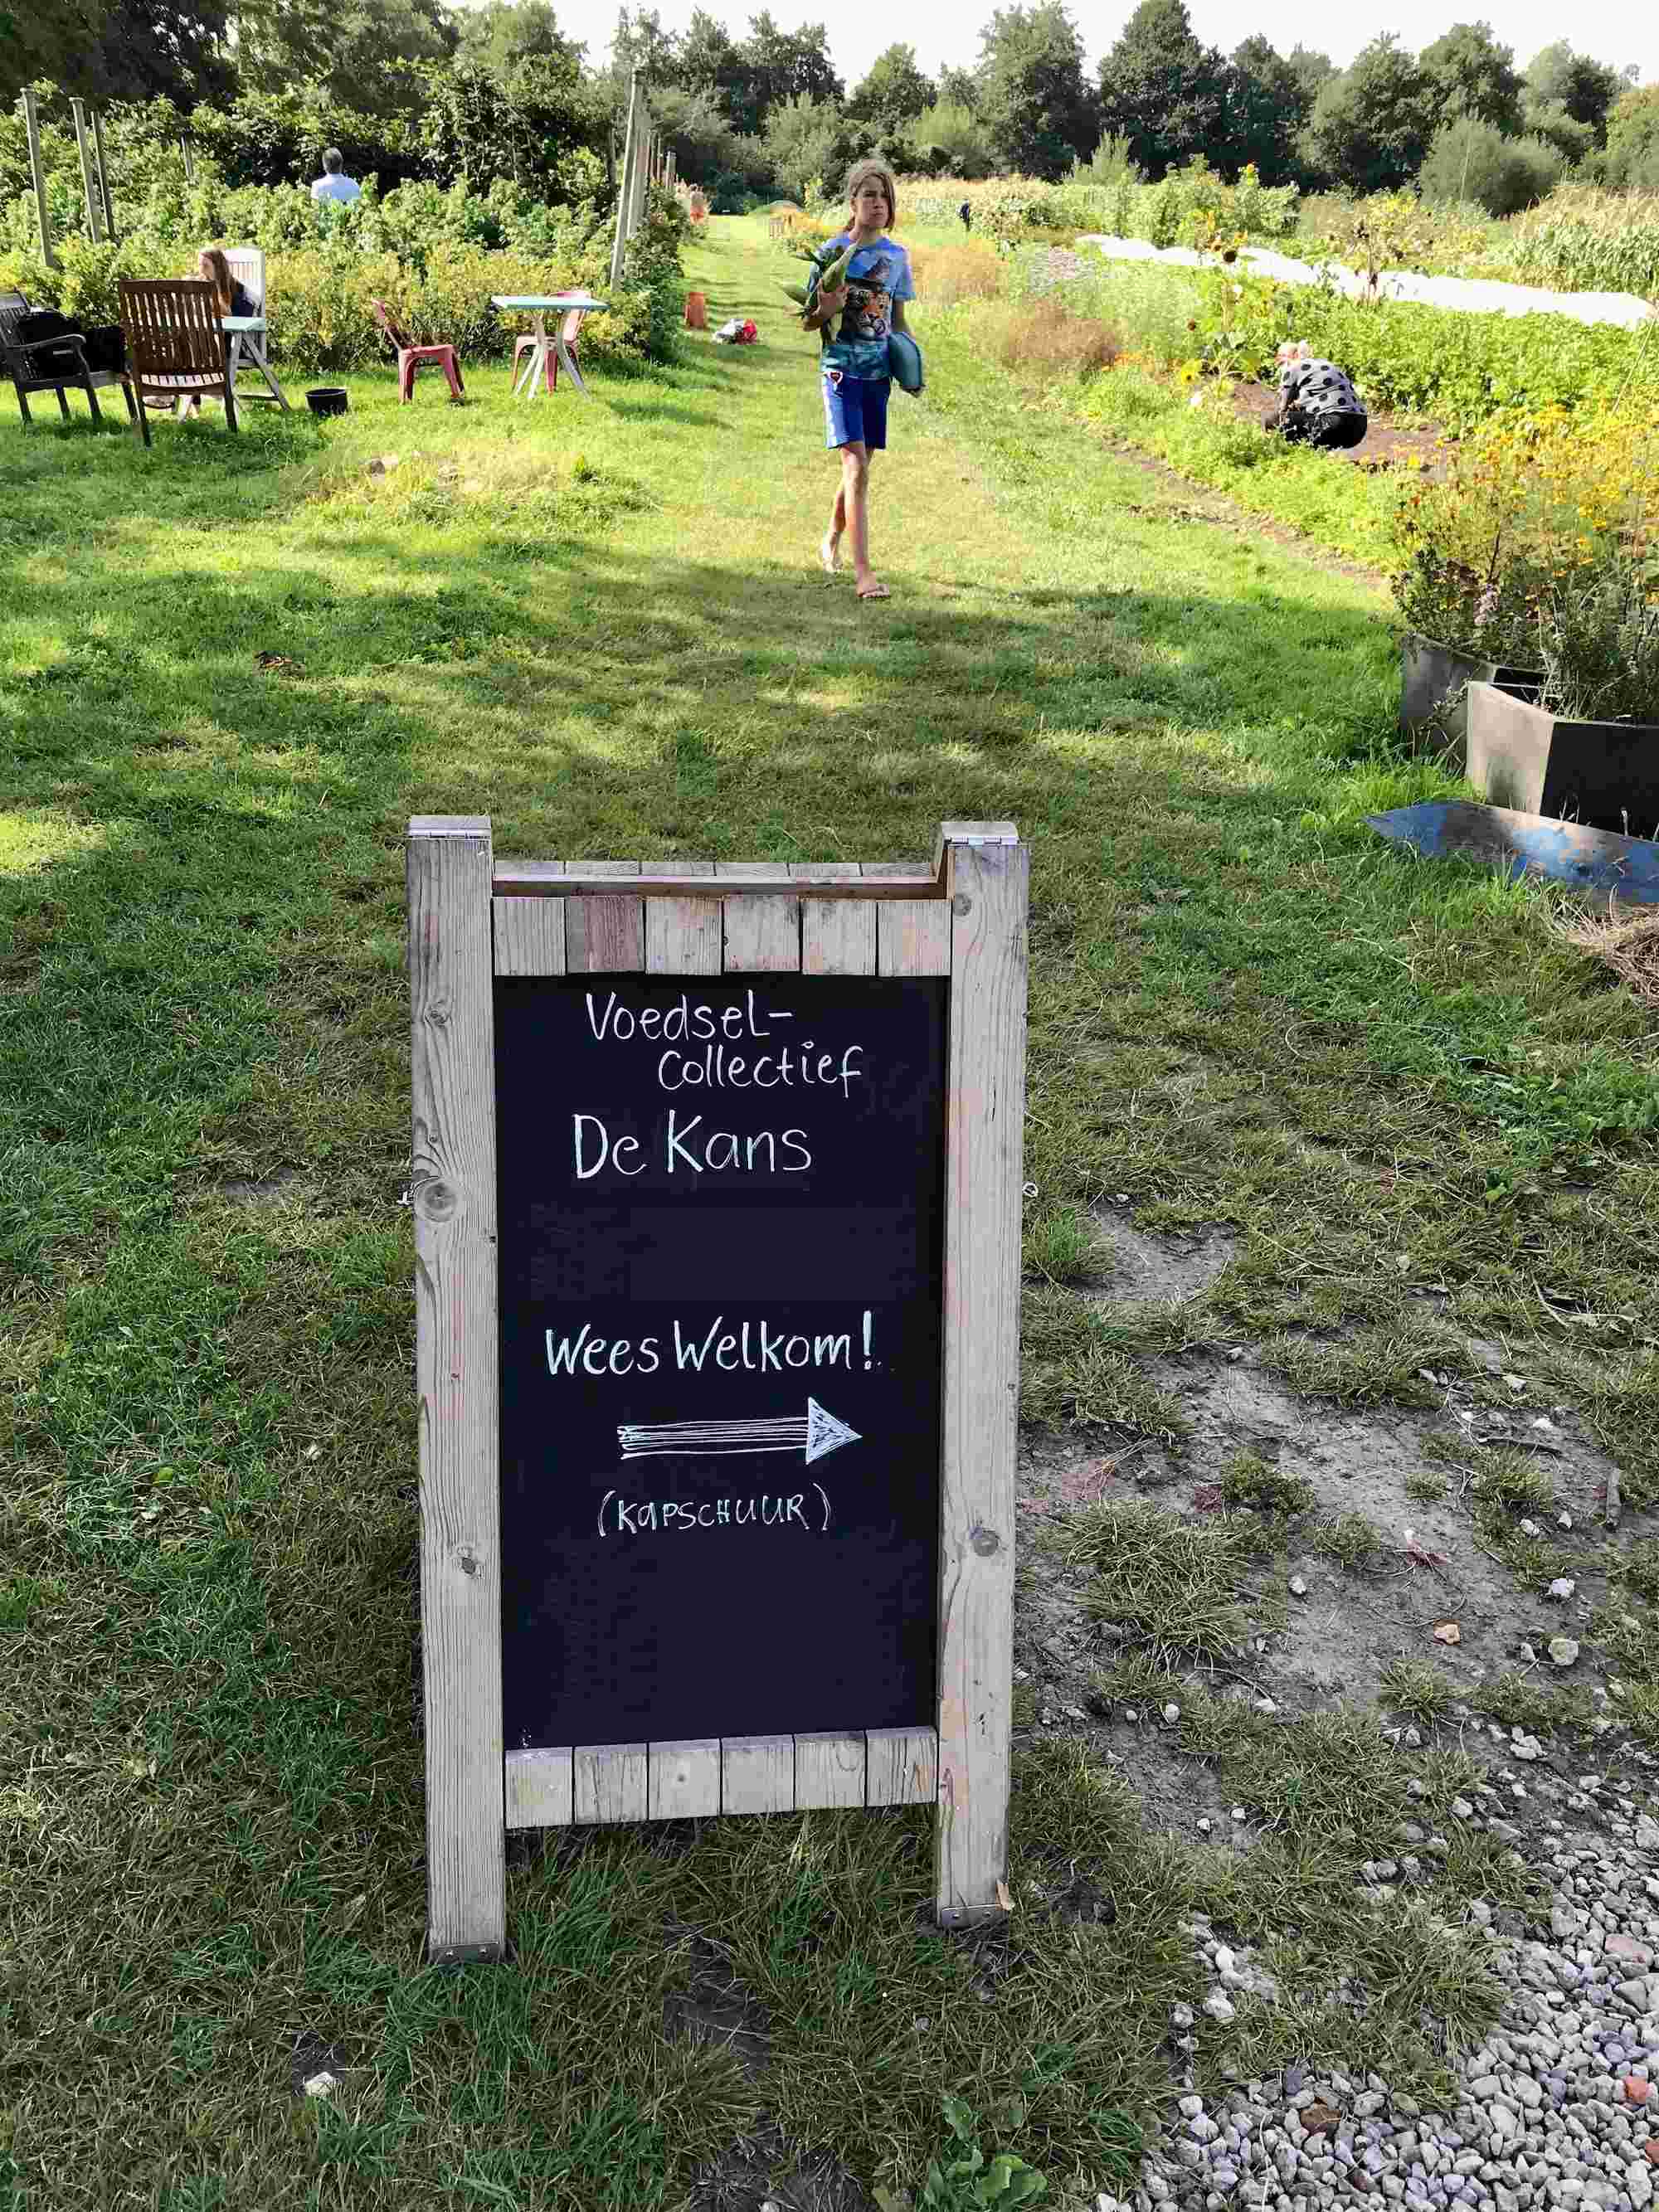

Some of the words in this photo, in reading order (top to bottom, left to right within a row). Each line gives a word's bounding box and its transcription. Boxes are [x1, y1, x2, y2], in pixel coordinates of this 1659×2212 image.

[658, 1040, 864, 1098] Collectief
[573, 1113, 647, 1179] De
[667, 1109, 812, 1174] Kans
[545, 1323, 659, 1375] Wees
[674, 1310, 873, 1373] Welkom!
